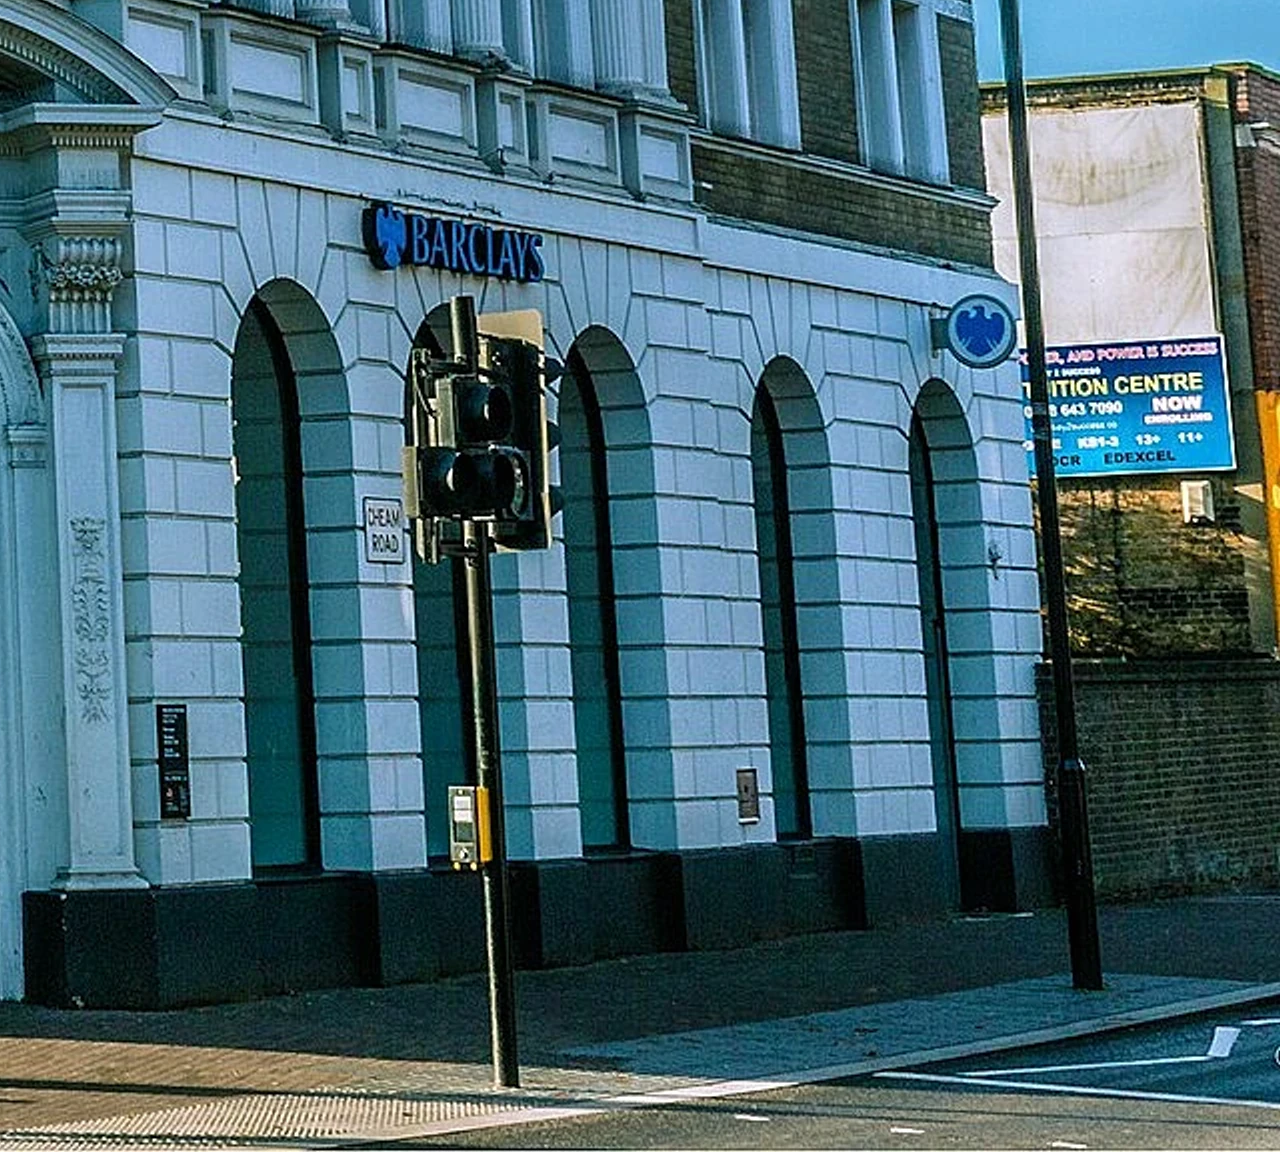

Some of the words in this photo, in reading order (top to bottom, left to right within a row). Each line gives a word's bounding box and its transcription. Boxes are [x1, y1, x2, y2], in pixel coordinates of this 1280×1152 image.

[412, 215, 546, 281] BARCLAYS
[1067, 349, 1095, 363] AND
[1097, 346, 1145, 360] POWER
[1161, 342, 1218, 357] SUCCESS
[1021, 377, 1109, 399] TITION
[1113, 372, 1204, 394] CENTRE
[1060, 401, 1087, 417] 643
[1088, 399, 1124, 416] 7090
[1152, 395, 1203, 413] NOW
[1135, 433, 1162, 446] 13+
[1103, 450, 1177, 465] EDEXCEL
[368, 507, 401, 528] CHEAM
[371, 532, 400, 553] ROAD
